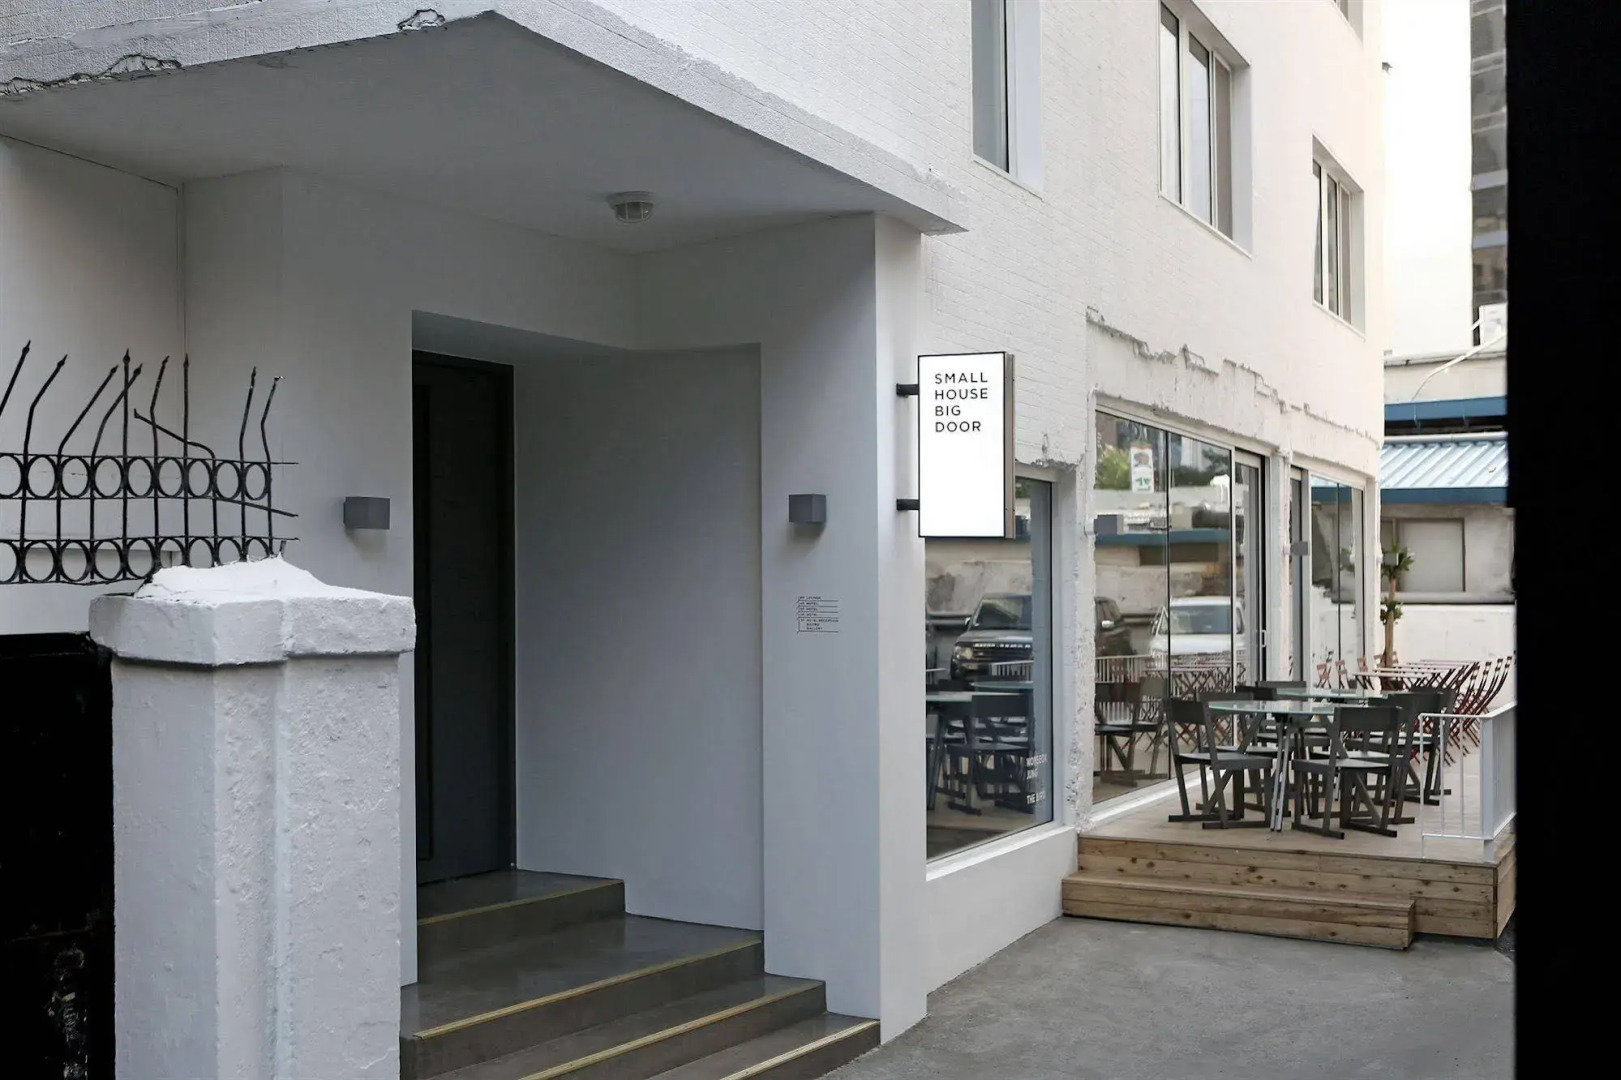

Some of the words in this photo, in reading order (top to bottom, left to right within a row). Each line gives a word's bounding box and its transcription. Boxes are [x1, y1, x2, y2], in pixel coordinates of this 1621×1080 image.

[934, 372, 988, 384] SMALL
[934, 388, 988, 400] HOUSE
[935, 405, 961, 416] BIG
[935, 421, 982, 432] DOOR
[1026, 793, 1036, 804] THE
